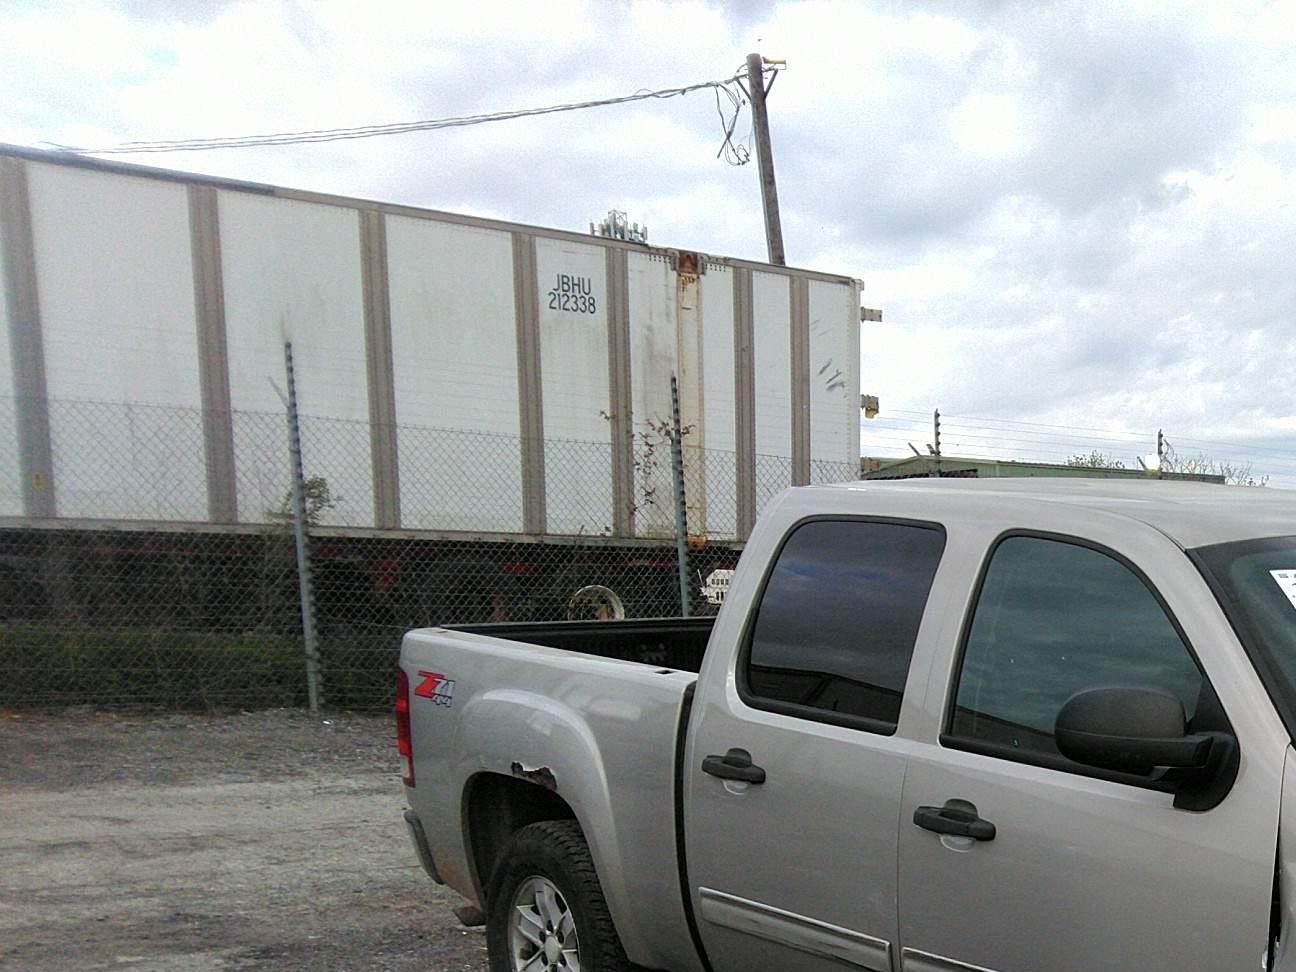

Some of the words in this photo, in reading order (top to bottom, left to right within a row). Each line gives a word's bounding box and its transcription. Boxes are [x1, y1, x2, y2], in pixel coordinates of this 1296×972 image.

[552, 273, 592, 296] JBHU
[548, 291, 597, 315] 212338
[415, 670, 456, 699] Z71
